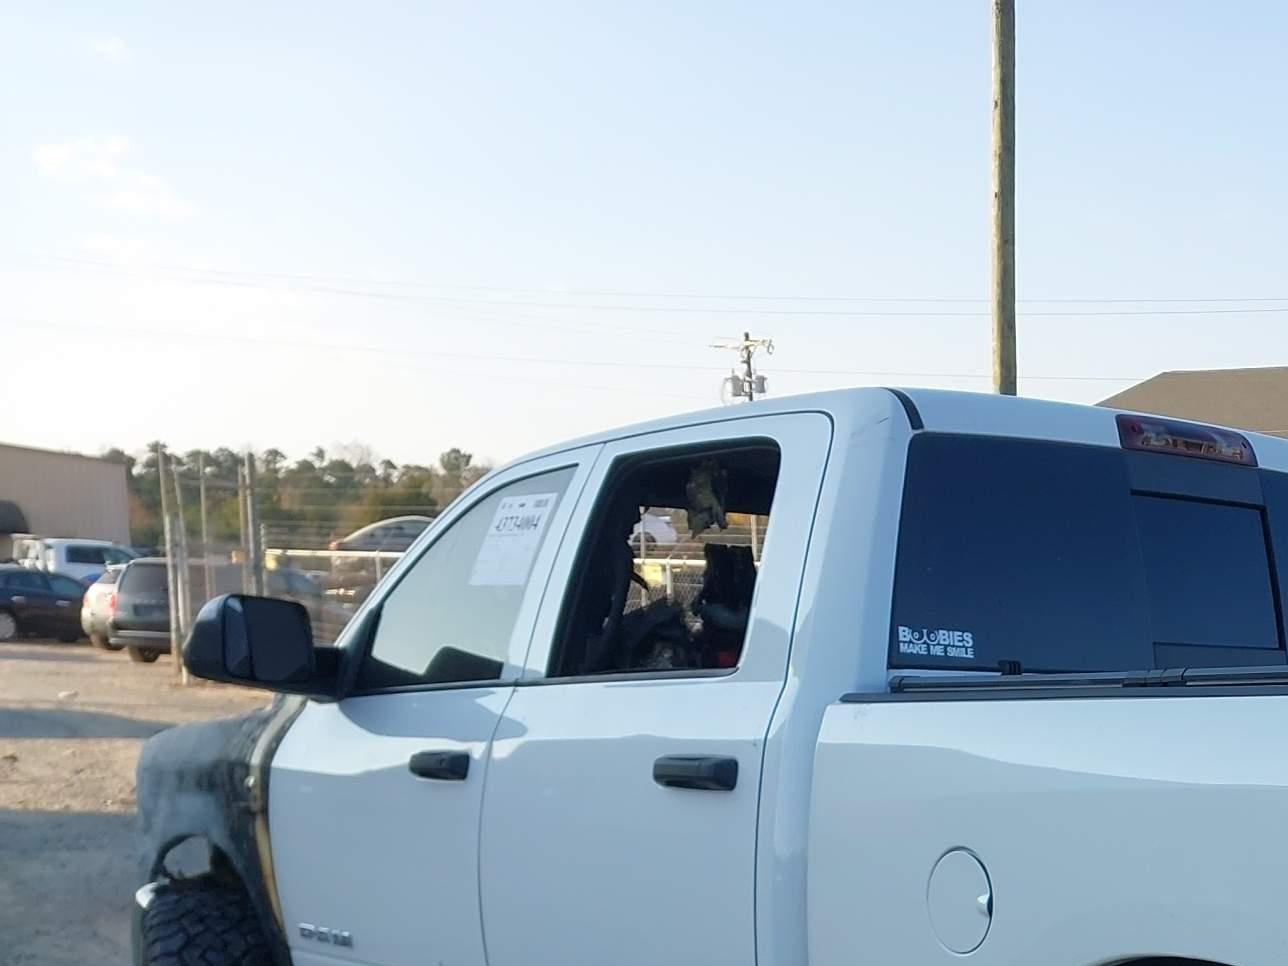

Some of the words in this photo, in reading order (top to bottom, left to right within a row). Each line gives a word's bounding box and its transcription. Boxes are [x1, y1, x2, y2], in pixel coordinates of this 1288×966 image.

[899, 642, 928, 655] MAKE
[930, 644, 945, 656] ME
[946, 646, 974, 658] SMILE
